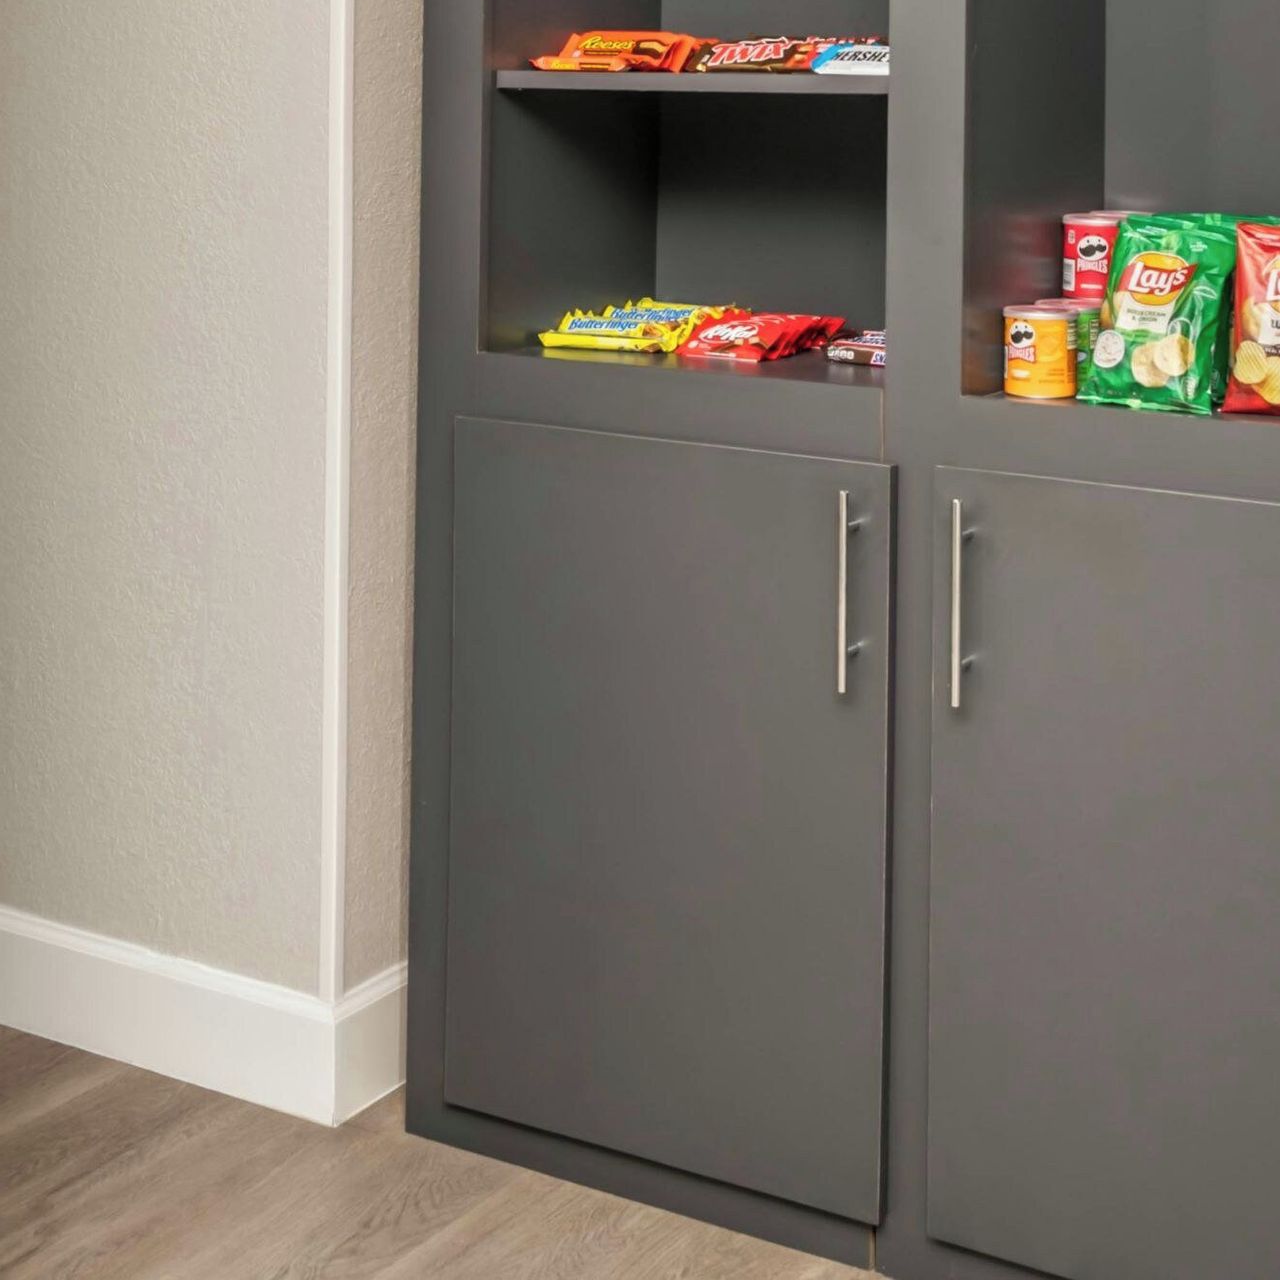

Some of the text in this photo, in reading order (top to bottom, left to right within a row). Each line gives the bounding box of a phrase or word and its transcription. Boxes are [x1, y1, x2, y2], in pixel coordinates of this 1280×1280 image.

[709, 41, 788, 66] TWIX
[832, 50, 889, 62] HERSHE
[1128, 261, 1188, 295] Lay's
